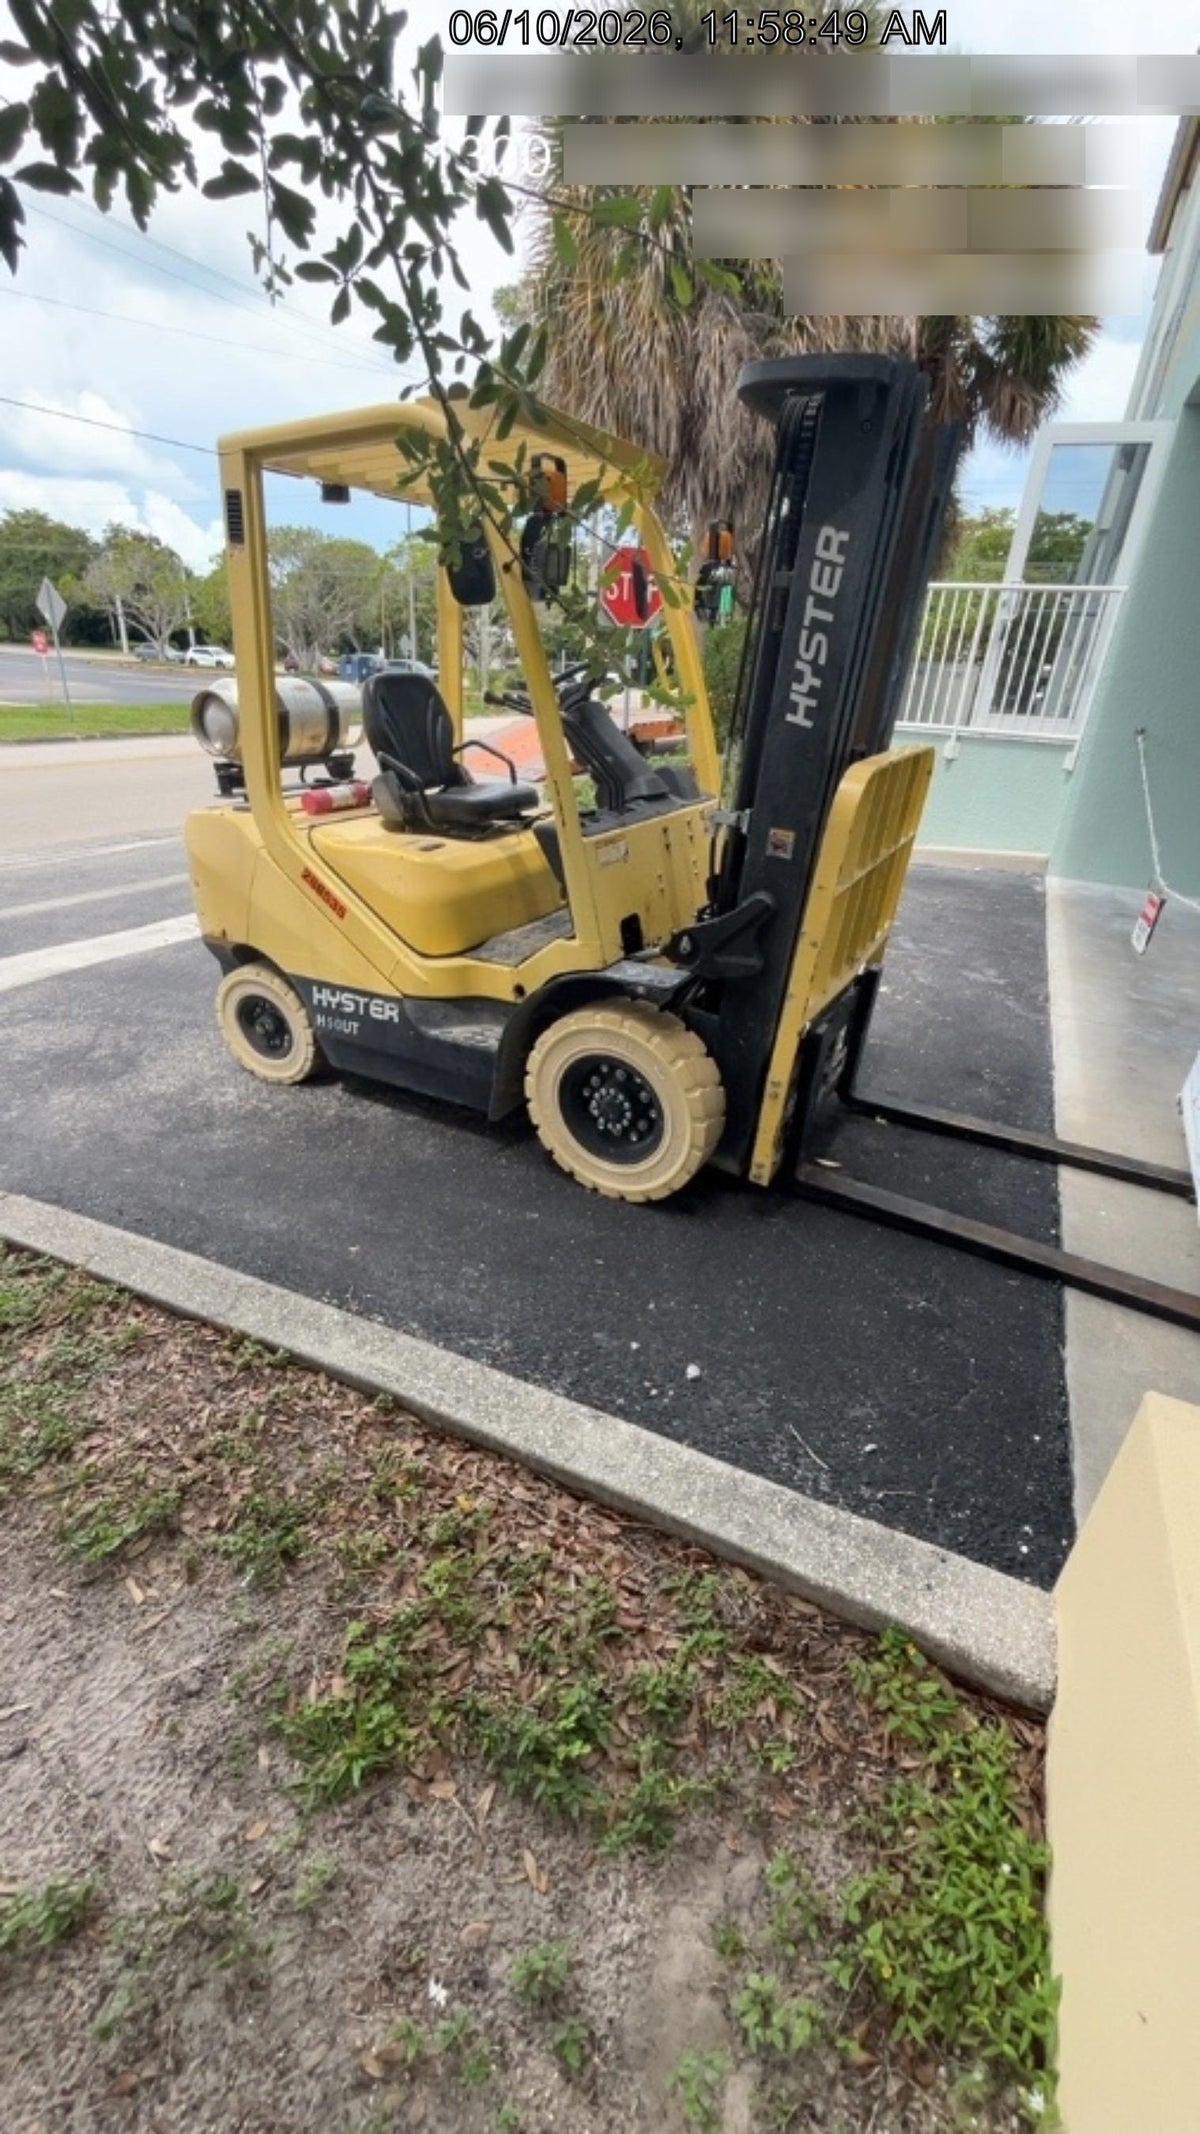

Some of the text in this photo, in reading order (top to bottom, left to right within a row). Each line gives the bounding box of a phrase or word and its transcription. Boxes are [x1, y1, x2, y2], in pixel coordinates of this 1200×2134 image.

[605, 571, 659, 603] STP
[784, 524, 850, 729] HYSTER
[312, 985, 400, 1024] HYSTER
